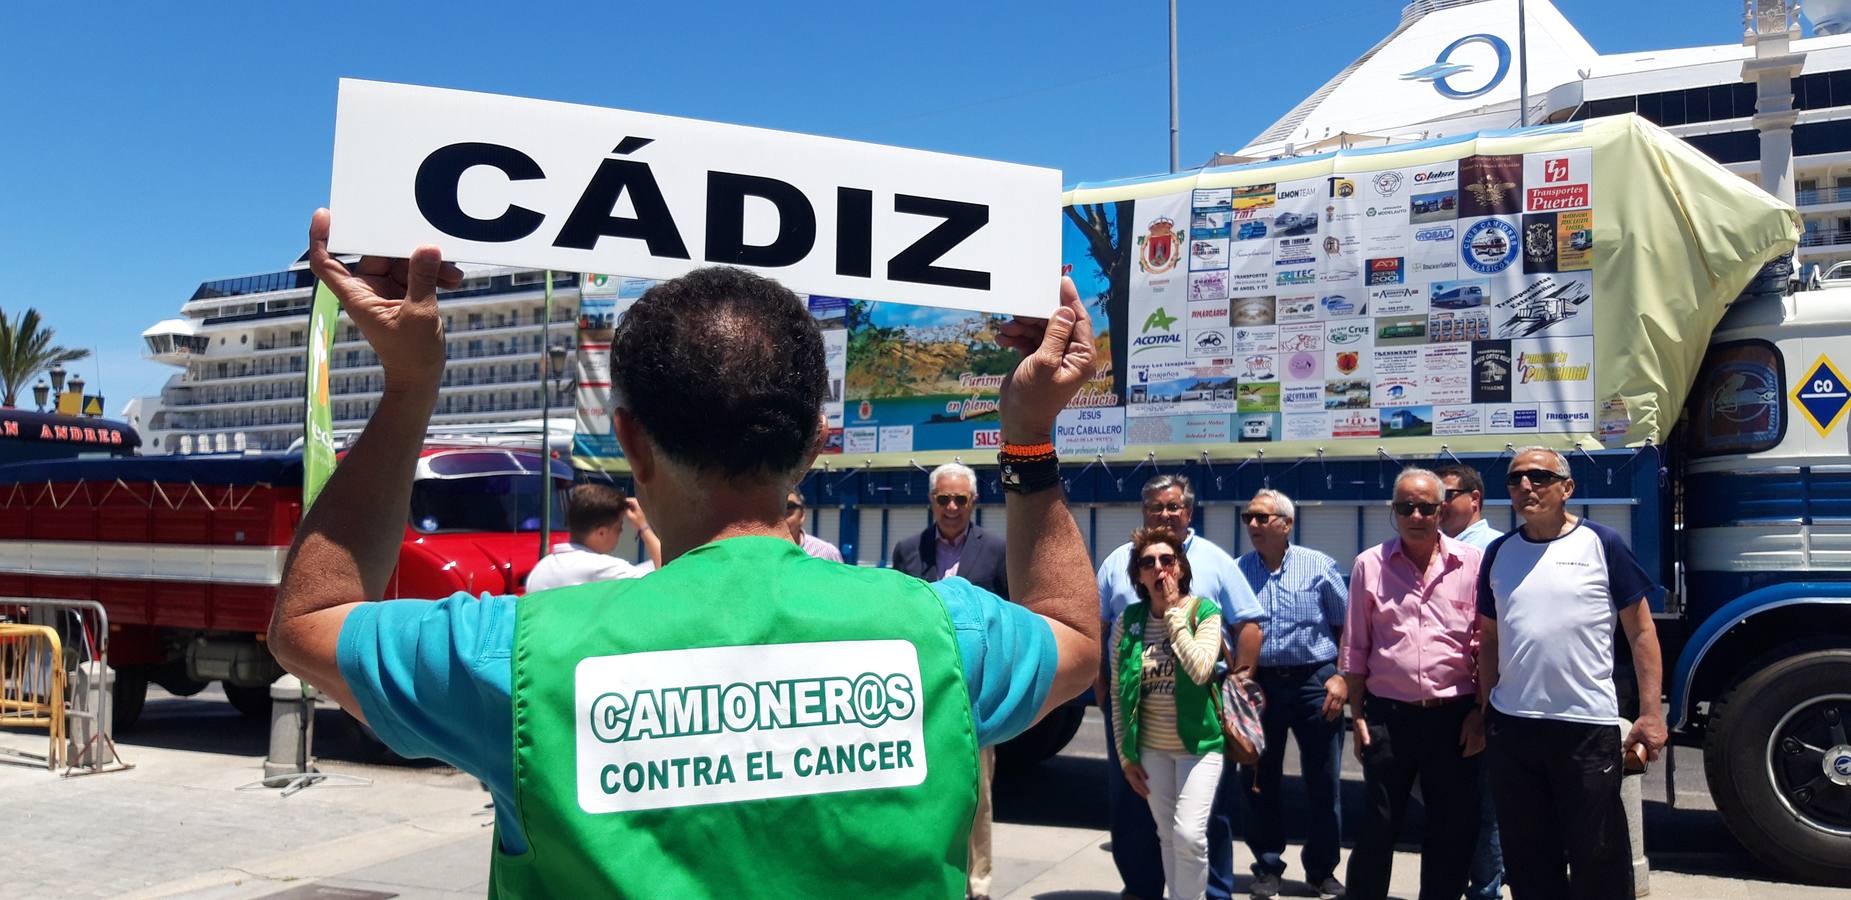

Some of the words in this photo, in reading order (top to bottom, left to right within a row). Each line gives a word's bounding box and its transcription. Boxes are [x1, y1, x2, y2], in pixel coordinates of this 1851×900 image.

[1277, 187, 1316, 200] LEMONTEAM
[1532, 186, 1583, 197] Transportes
[1532, 195, 1584, 210] Puerta
[414, 135, 991, 291] CÁDIZ
[1463, 226, 1478, 249] CLUB
[1480, 221, 1517, 246] CAMIONES
[1494, 276, 1552, 309] Transportistas
[1509, 283, 1556, 310] Extremeños
[1348, 325, 1369, 334] Cruz
[1133, 333, 1182, 346] ACOTRAL
[960, 373, 1001, 387] Turism
[1814, 379, 1833, 393] CO
[946, 402, 960, 413] en
[960, 394, 995, 420] pleno
[40, 424, 122, 445] ANDRES
[1058, 426, 1075, 436] RUIZ
[1076, 425, 1122, 435] CABALLERO
[975, 431, 1001, 446] SALS
[591, 672, 916, 743] CAMIONER@S
[600, 754, 736, 795] CONTRA
[746, 751, 783, 782] EL
[793, 740, 914, 777] CANCER
